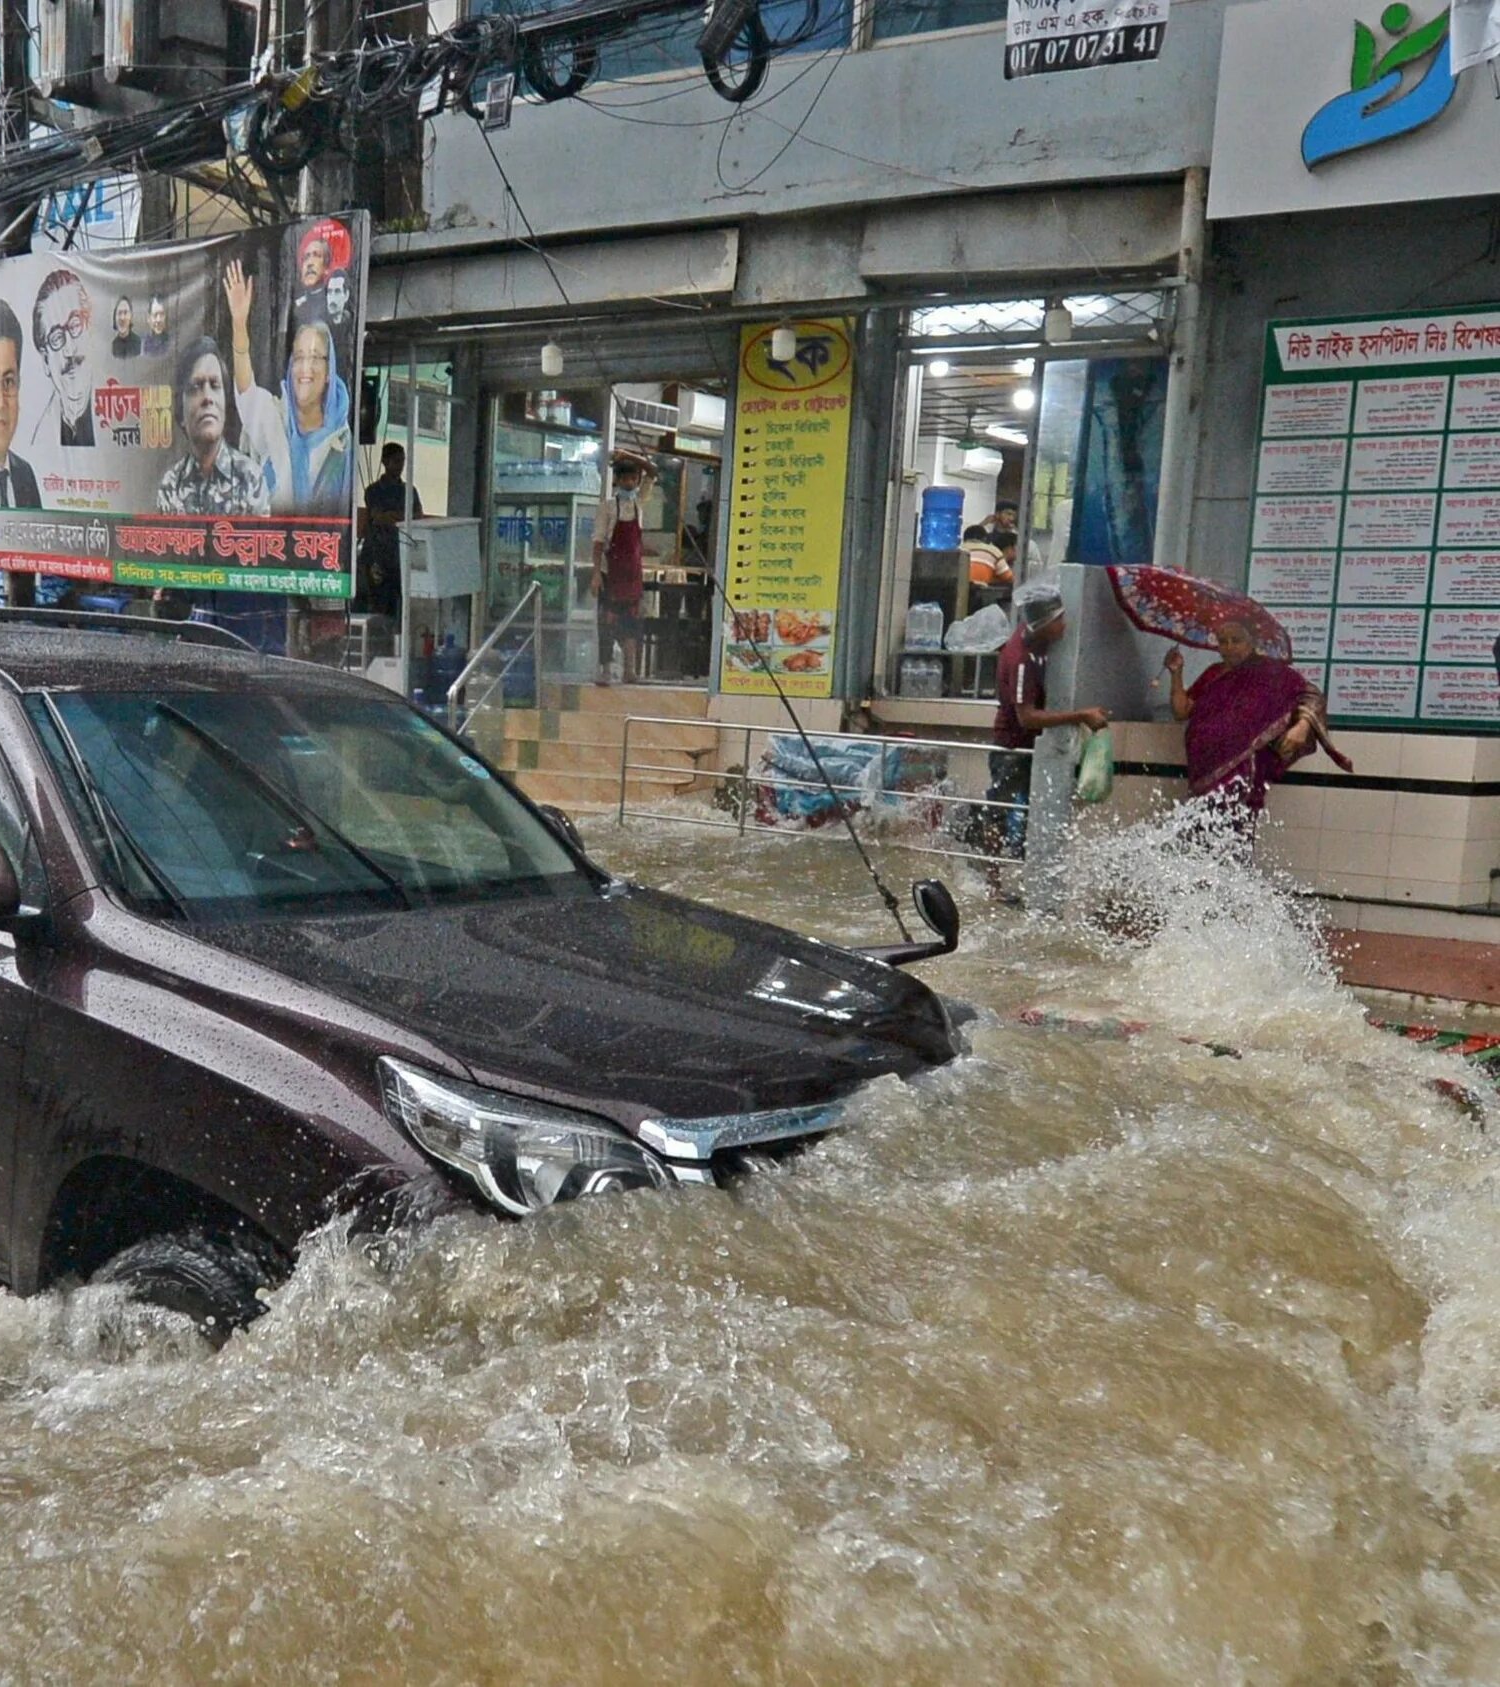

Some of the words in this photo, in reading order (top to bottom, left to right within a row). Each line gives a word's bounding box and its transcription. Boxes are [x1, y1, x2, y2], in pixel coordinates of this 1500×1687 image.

[1037, 16, 1060, 31] এম
[1065, 14, 1076, 27] এ
[1010, 41, 1041, 70] 017
[1045, 39, 1070, 64] 07
[1074, 34, 1099, 61] 07
[1102, 30, 1125, 57] 31
[1133, 26, 1157, 52] 41
[1287, 332, 1312, 360] নিউ
[1316, 331, 1353, 361] লাইফ
[1358, 327, 1419, 359] হসপিটাল
[1424, 323, 1447, 353] লিঃ
[95, 377, 140, 429] মুজিব
[115, 525, 207, 556] আহাম্মদ
[212, 520, 287, 566] উল্লাহ
[292, 529, 342, 572] মধু
[118, 564, 155, 581] সিনিয়র
